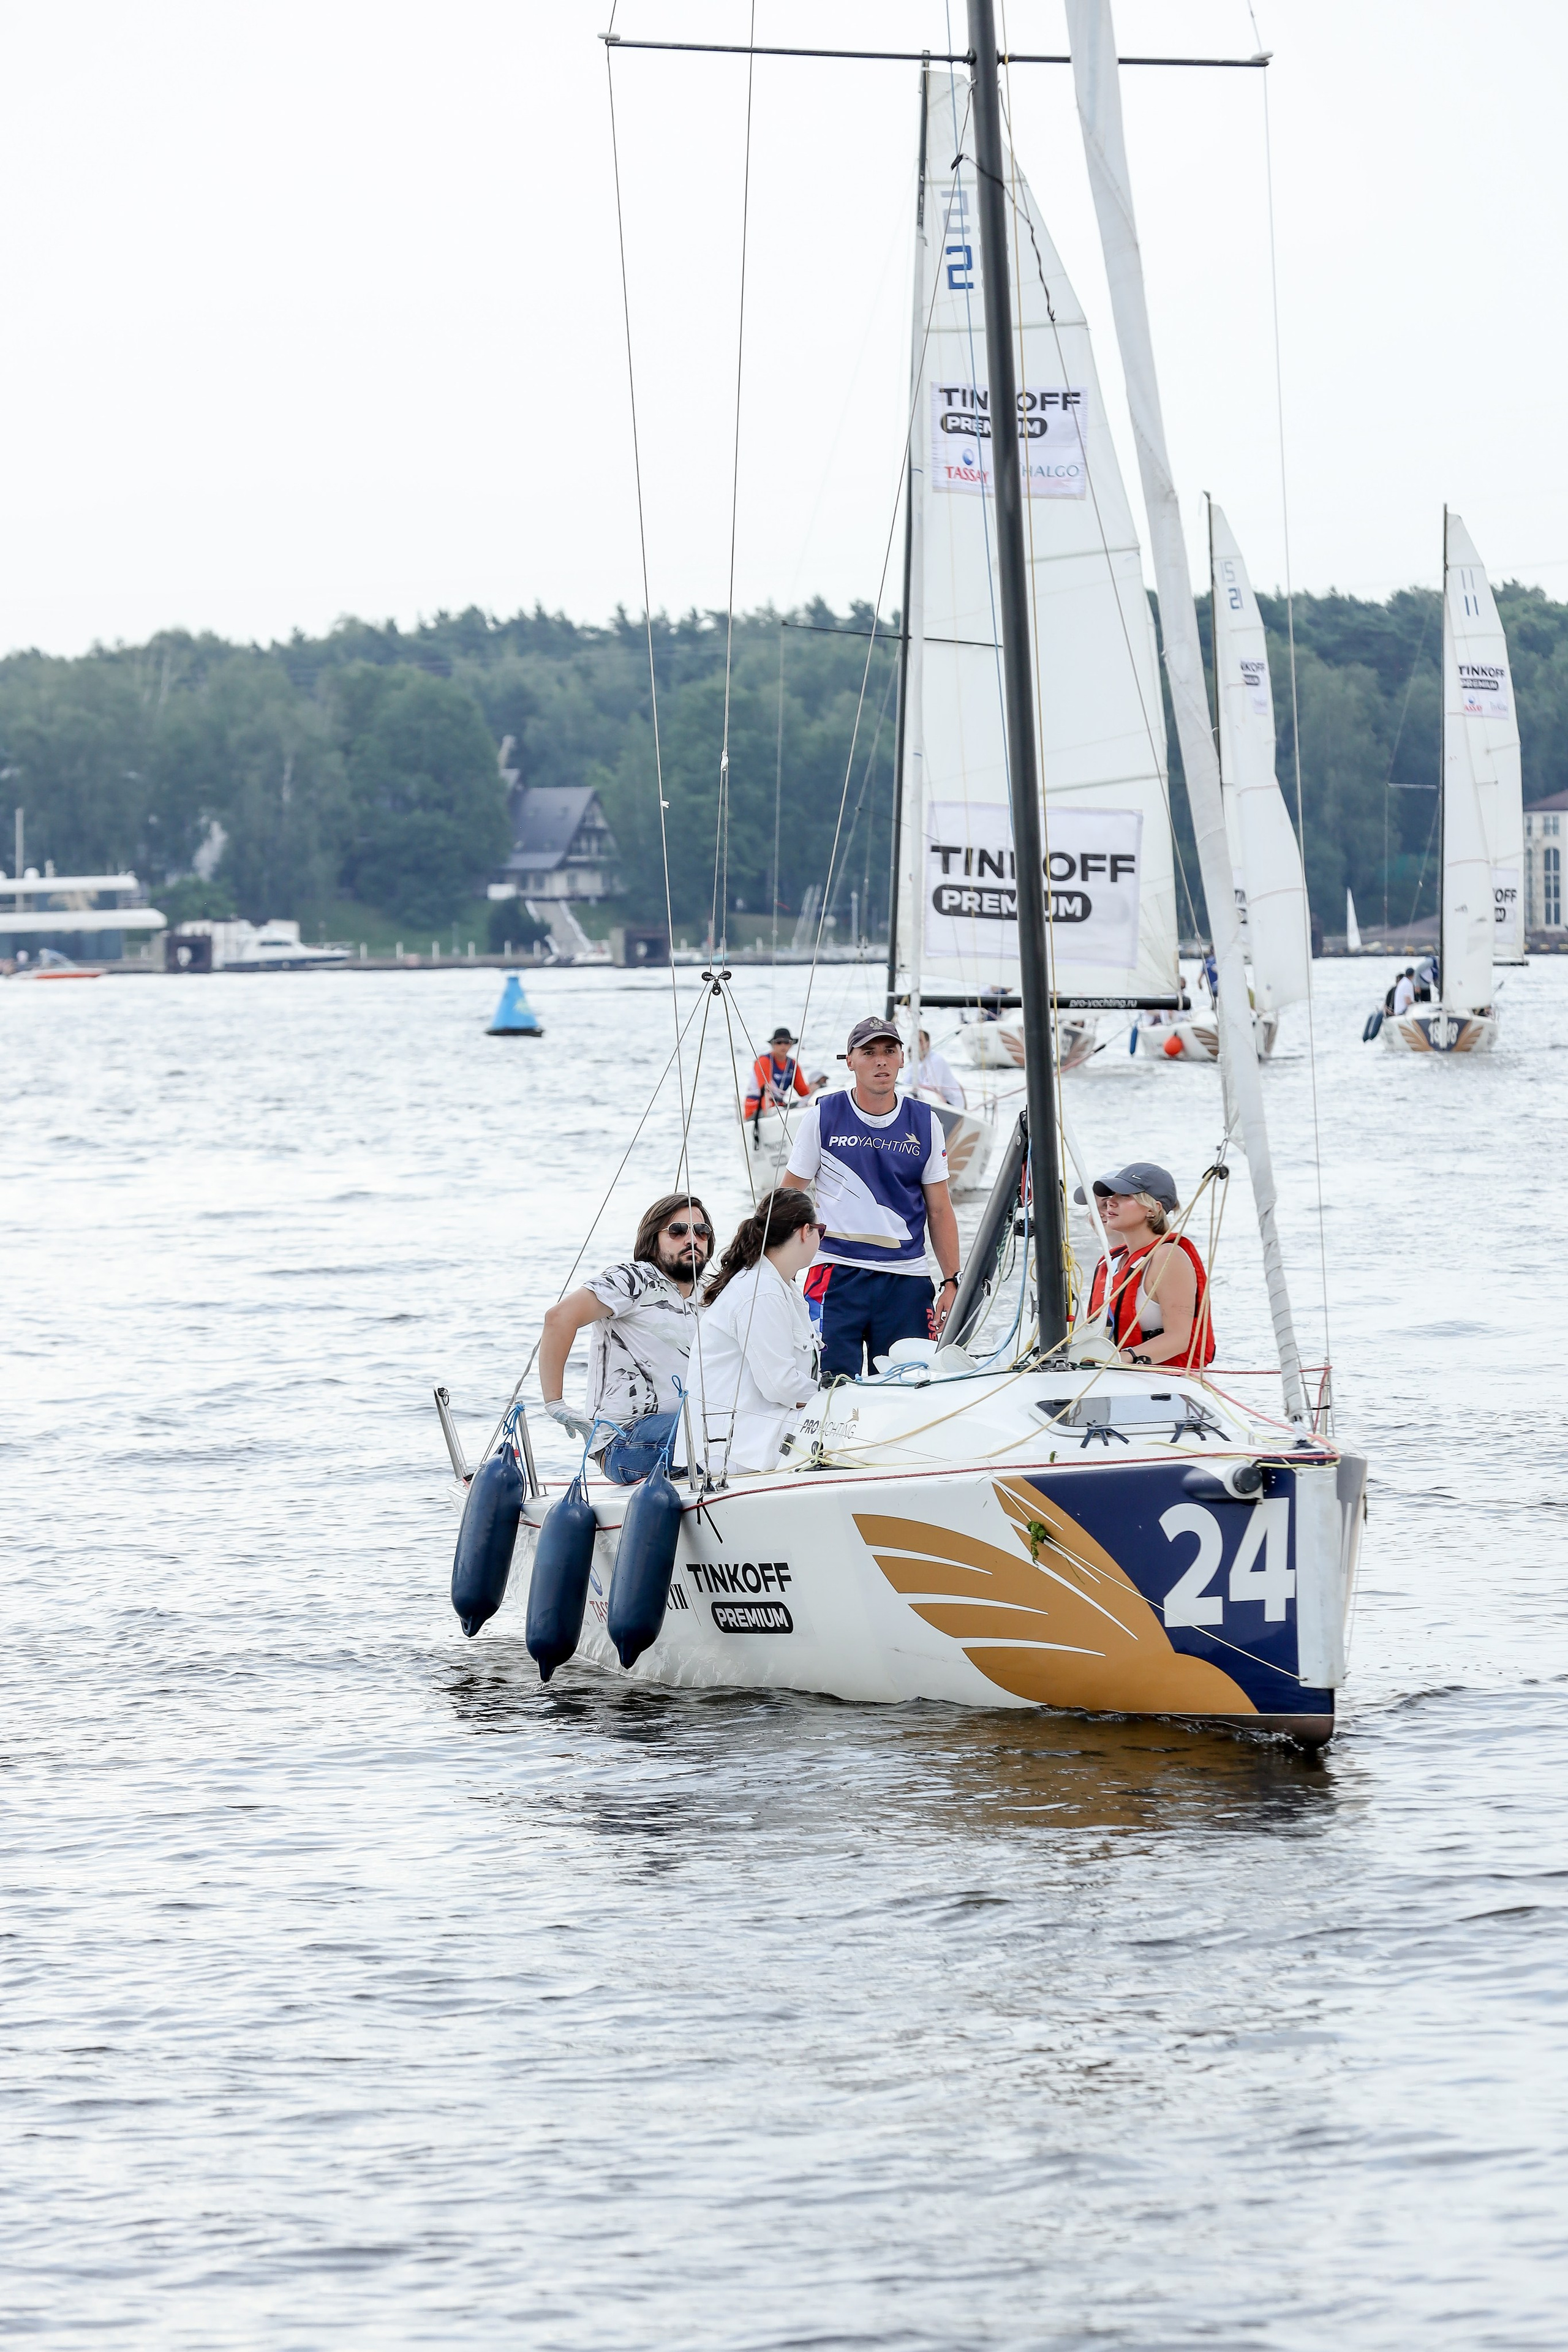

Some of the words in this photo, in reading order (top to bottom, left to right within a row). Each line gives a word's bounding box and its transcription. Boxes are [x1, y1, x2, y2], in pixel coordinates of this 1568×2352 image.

[946, 245, 984, 290] 2
[940, 387, 1080, 411] TINOFF
[944, 466, 989, 484] TASSAY
[1019, 462, 1079, 478] HALGO
[1458, 665, 1505, 678] TINKOFF
[941, 889, 1082, 917] PREMUM
[1069, 998, 1137, 1008] pro-yachting.ru
[1158, 1497, 1297, 1628] 24
[686, 1562, 792, 1594] TINKOFF
[715, 1608, 789, 1627] PREMIUM
